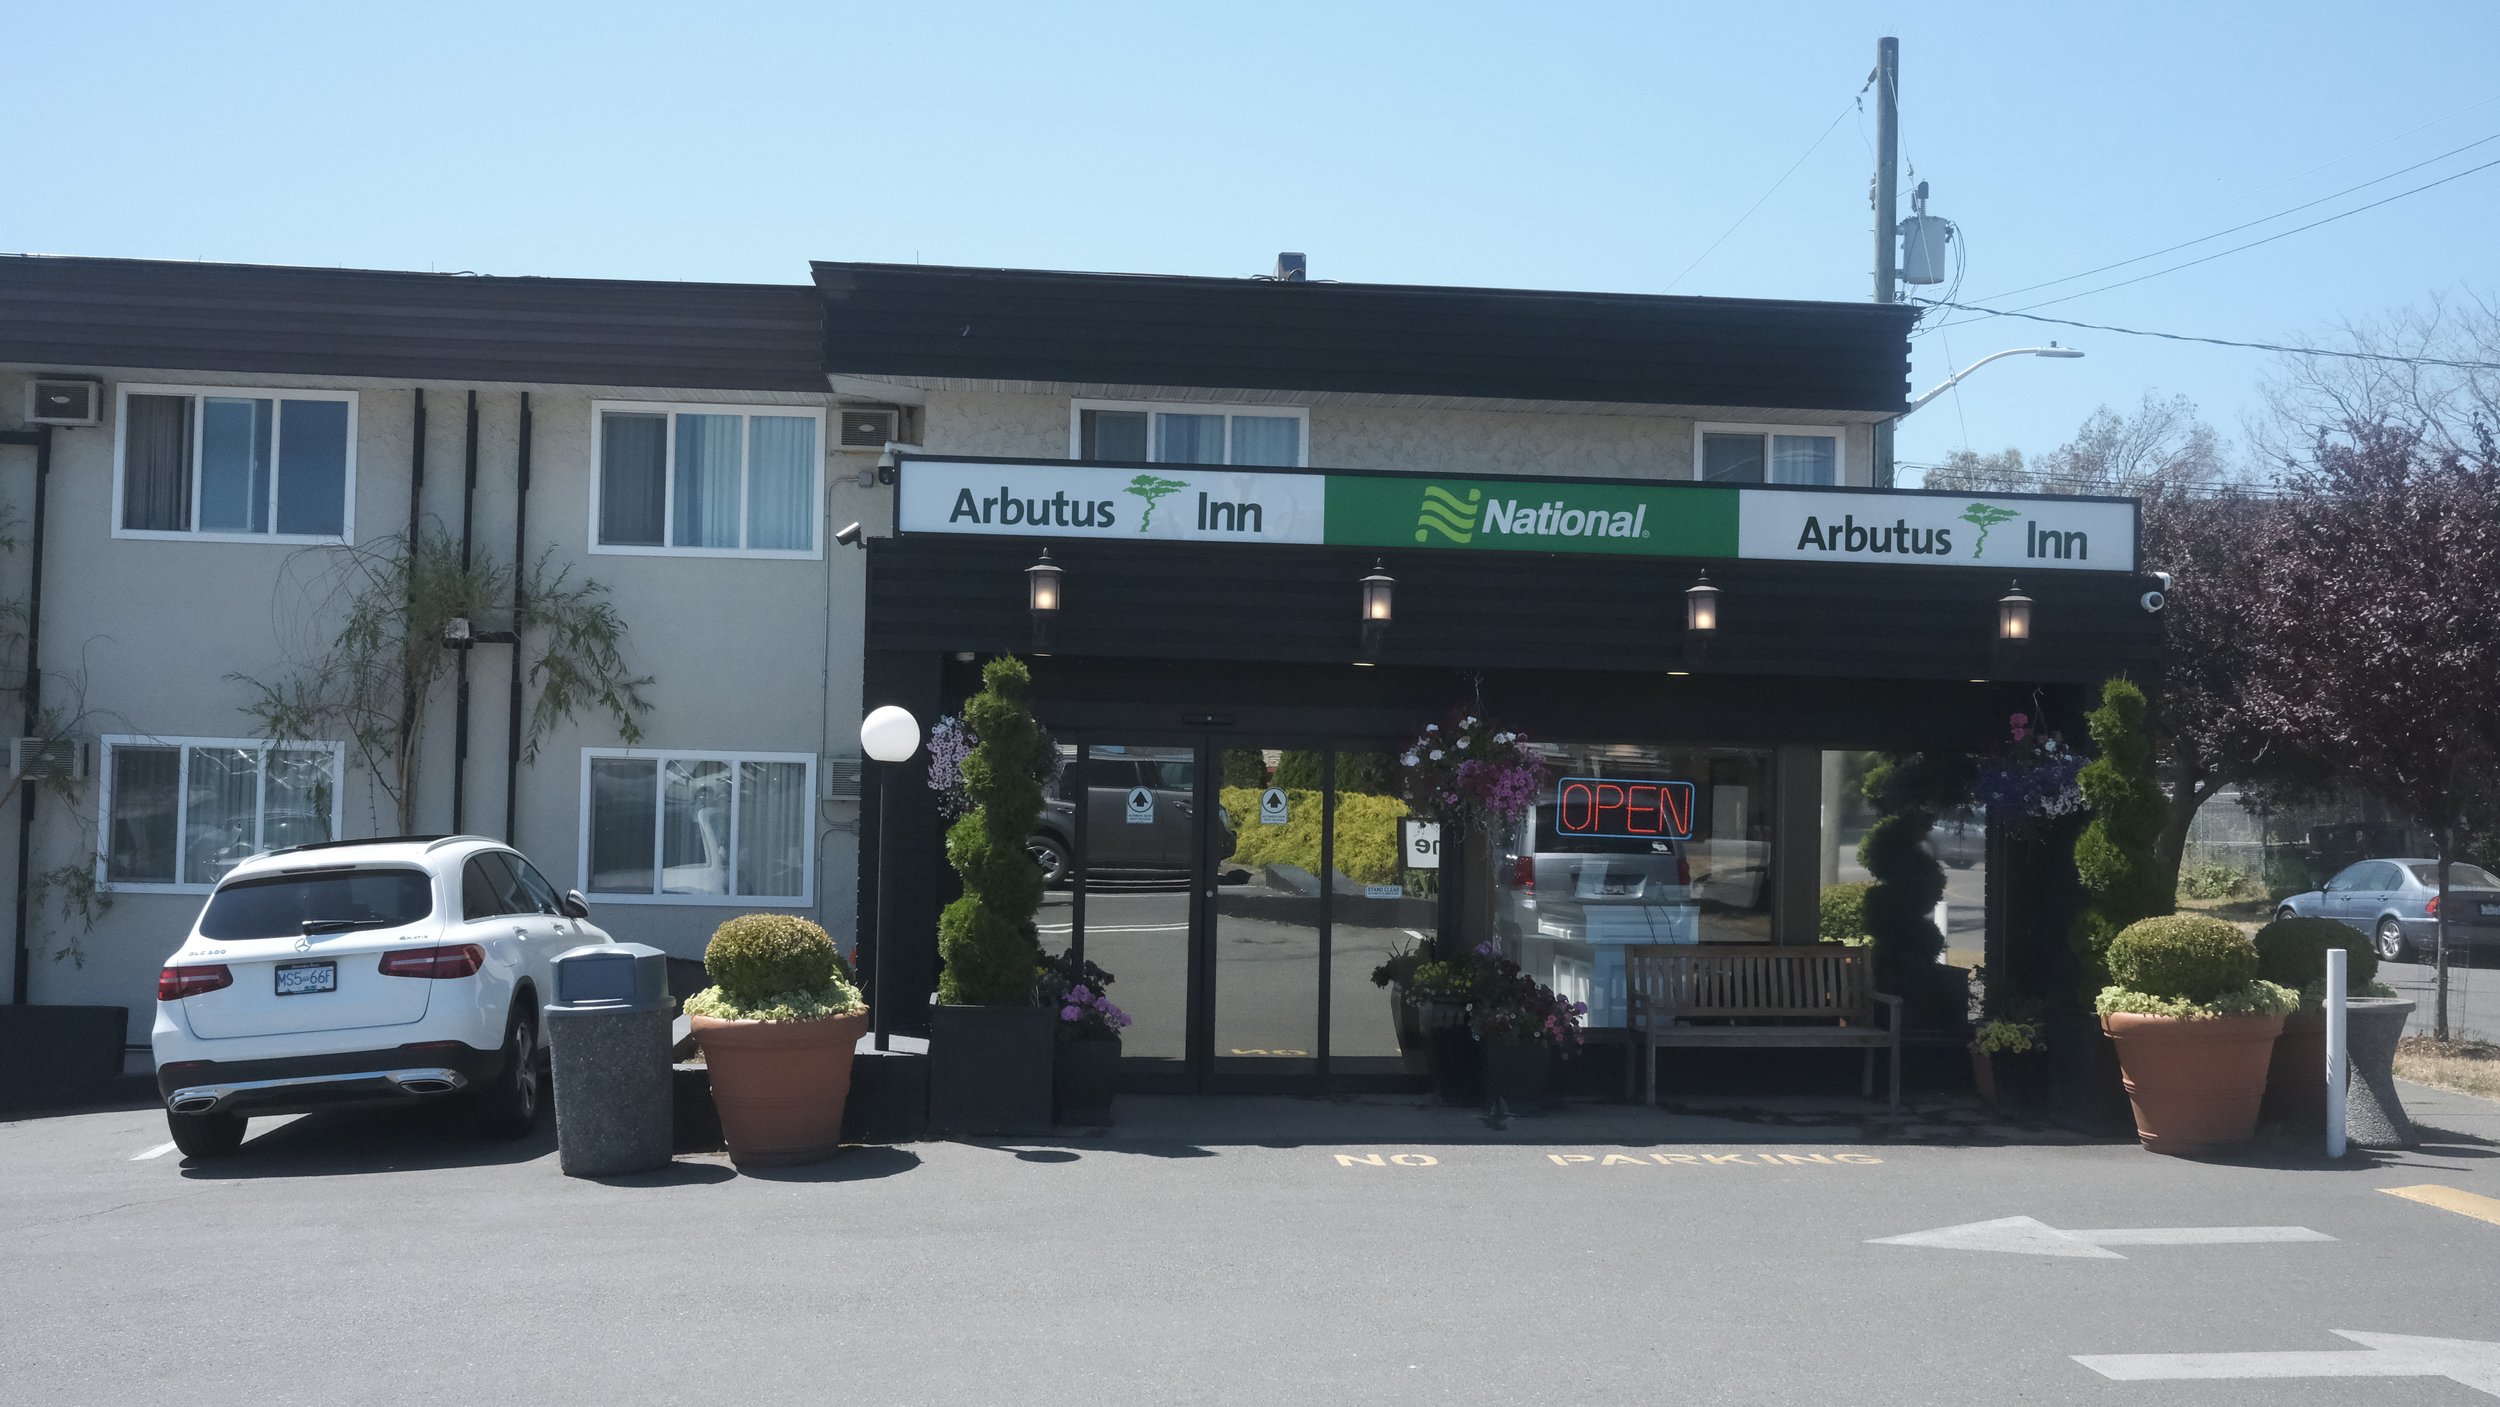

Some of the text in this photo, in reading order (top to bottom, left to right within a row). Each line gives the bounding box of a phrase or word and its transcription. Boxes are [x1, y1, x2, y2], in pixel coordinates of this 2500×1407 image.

[949, 486, 1263, 533] Arbutus Inn
[1796, 514, 2088, 561] Arbutus Inn
[1563, 783, 1689, 834] OPEN
[1333, 1152, 1886, 1169] NO PARKING
